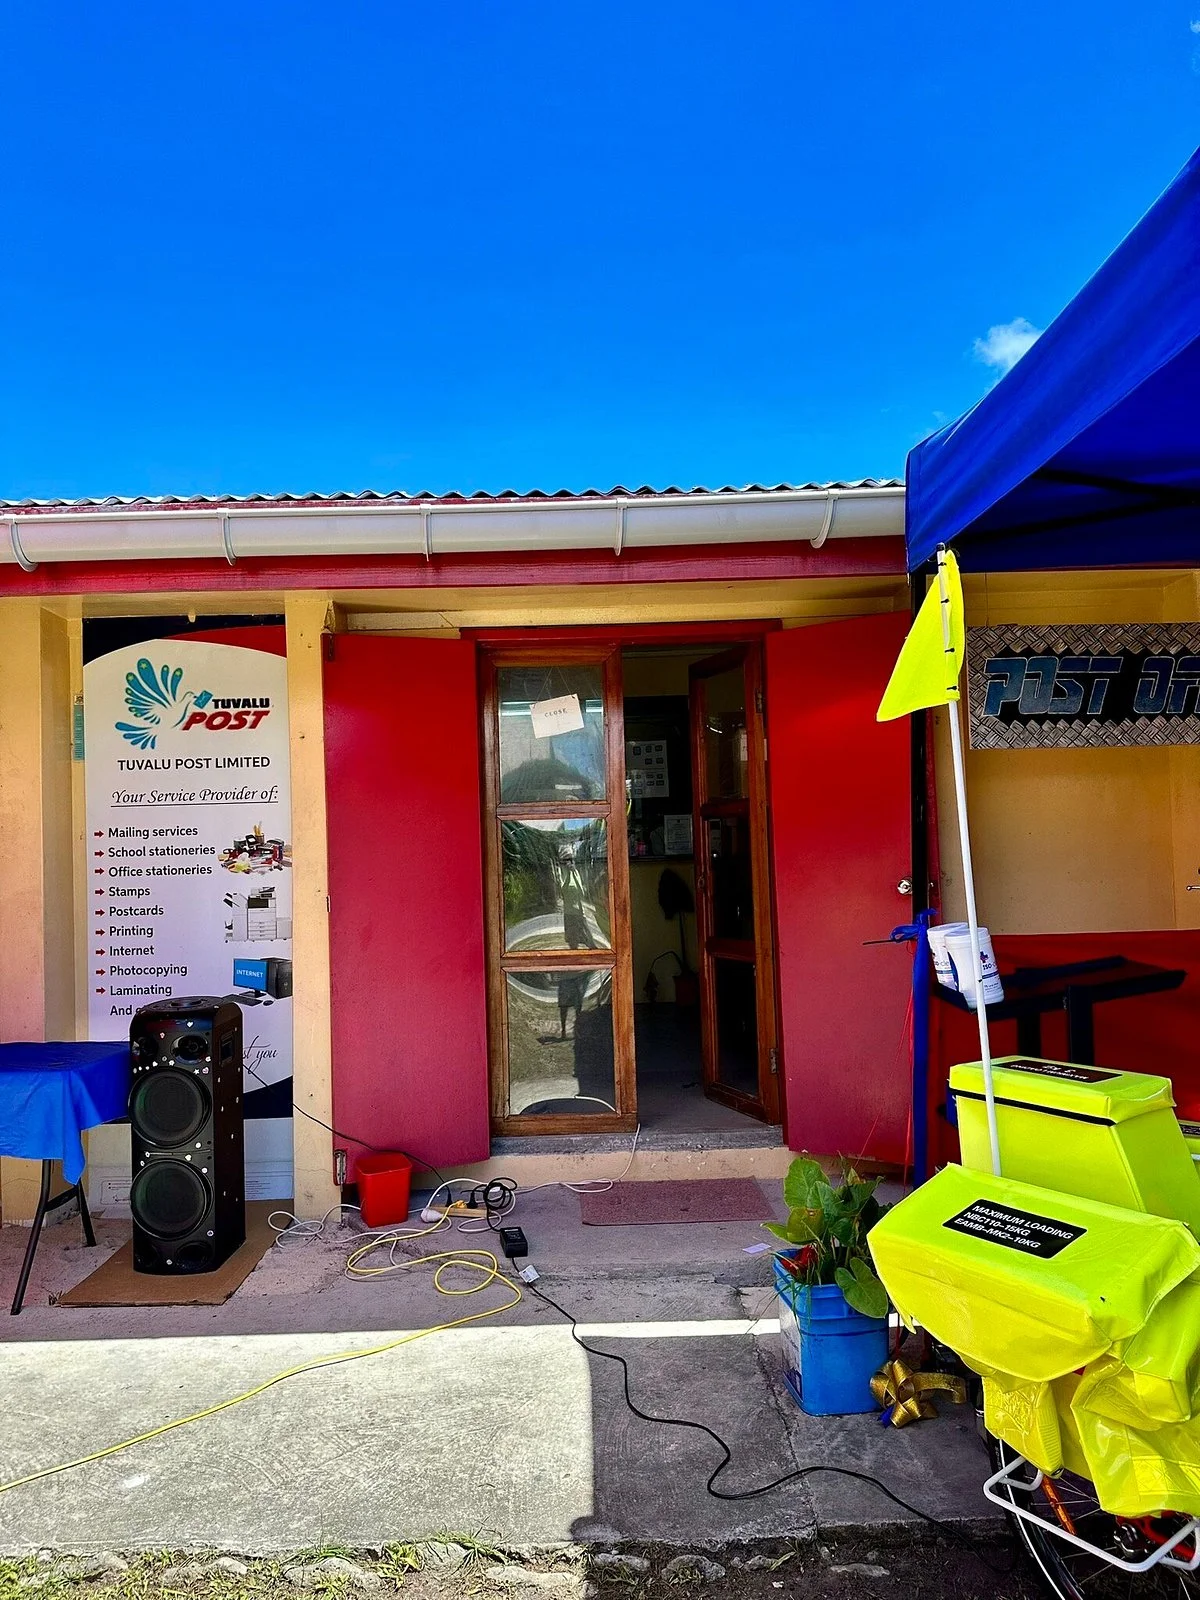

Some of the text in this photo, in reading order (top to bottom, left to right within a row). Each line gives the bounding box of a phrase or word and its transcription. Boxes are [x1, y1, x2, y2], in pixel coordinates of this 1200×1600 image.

[983, 656, 1124, 716] POST
[212, 698, 270, 709] TUVALU
[544, 707, 568, 718] CLOSE
[182, 711, 270, 731] POST
[117, 756, 270, 771] TUVALU POST LIMITED
[112, 785, 278, 804] Your Service Provider of:
[108, 826, 198, 839] Mailing services
[108, 845, 216, 858] School stationeries
[108, 864, 212, 877] Office stationeries
[108, 887, 150, 899] Stamps
[109, 905, 164, 917] Postcards
[109, 926, 154, 938] Printing
[109, 945, 155, 957] Internet
[110, 964, 188, 977] Photocopying
[236, 969, 264, 978] INTERNET
[110, 985, 172, 997] Laminating
[110, 1004, 133, 1016] And
[248, 1049, 278, 1075] you
[963, 1211, 1031, 1237] NBC110-15KG
[972, 1205, 1074, 1240] MAXIMUM LOADING
[954, 1218, 1042, 1249] EAMB-MK2-10KG
